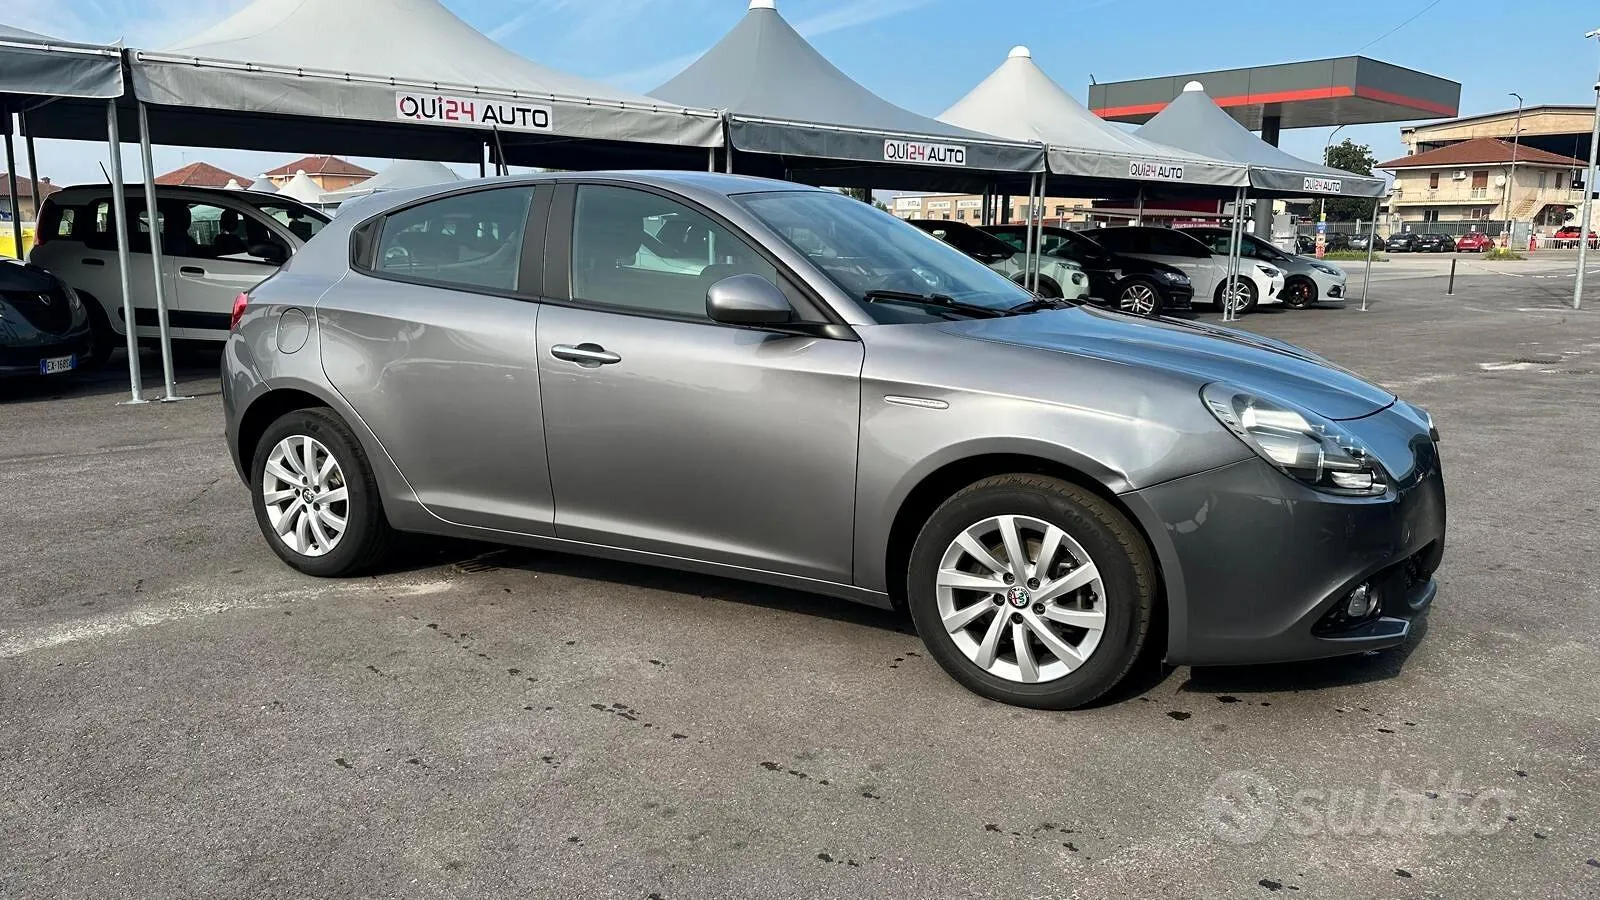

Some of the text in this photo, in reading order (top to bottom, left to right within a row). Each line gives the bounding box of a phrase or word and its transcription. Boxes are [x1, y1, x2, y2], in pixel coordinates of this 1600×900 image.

[481, 104, 549, 128] AUTO
[927, 147, 964, 163] AUTO
[1157, 166, 1183, 179] AUTO
[1322, 181, 1340, 192] AUTO
